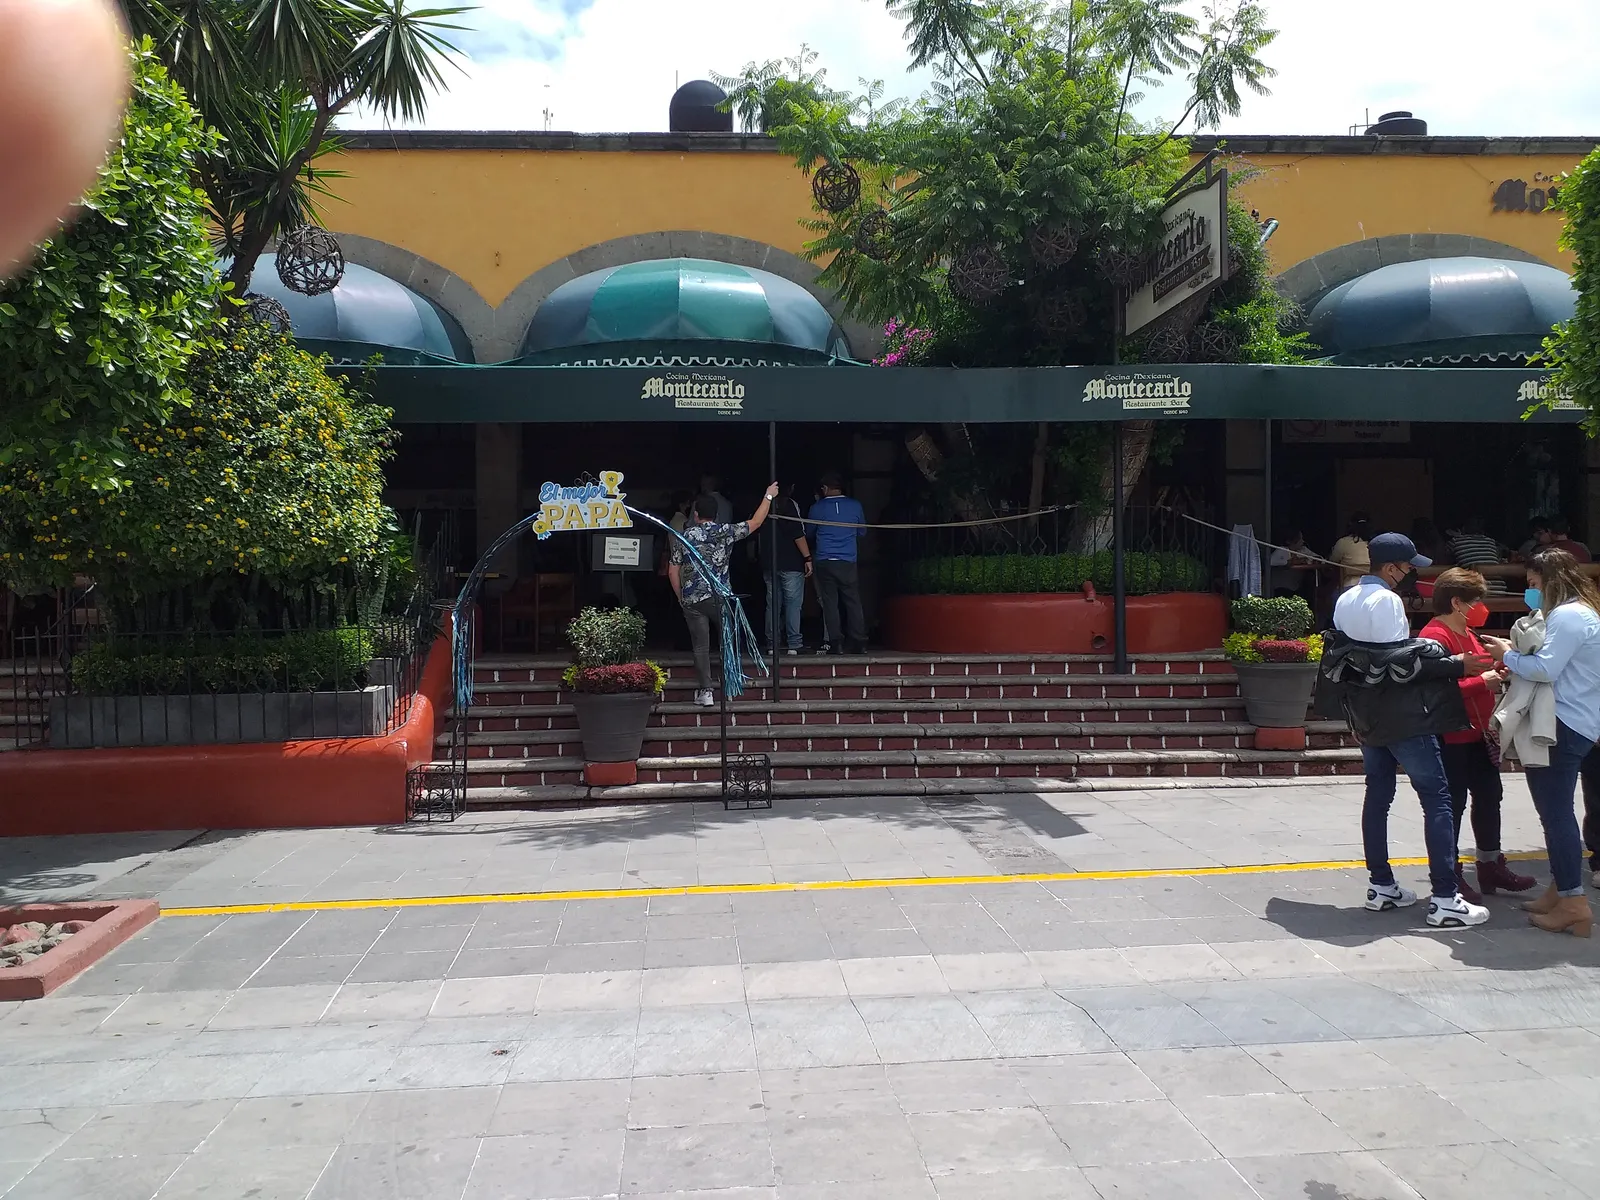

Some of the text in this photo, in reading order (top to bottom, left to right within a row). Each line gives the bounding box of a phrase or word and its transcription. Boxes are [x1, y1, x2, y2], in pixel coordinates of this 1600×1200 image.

[665, 372, 727, 381] Cocina Mexicana
[1105, 373, 1172, 382] Cocina Mexicana
[640, 377, 745, 400] Montecarlo
[1082, 377, 1192, 402] Montecarlo
[677, 399, 737, 407] Restaurante Bar
[1124, 398, 1184, 408] Restaurante Bar
[540, 482, 608, 504] El mejor
